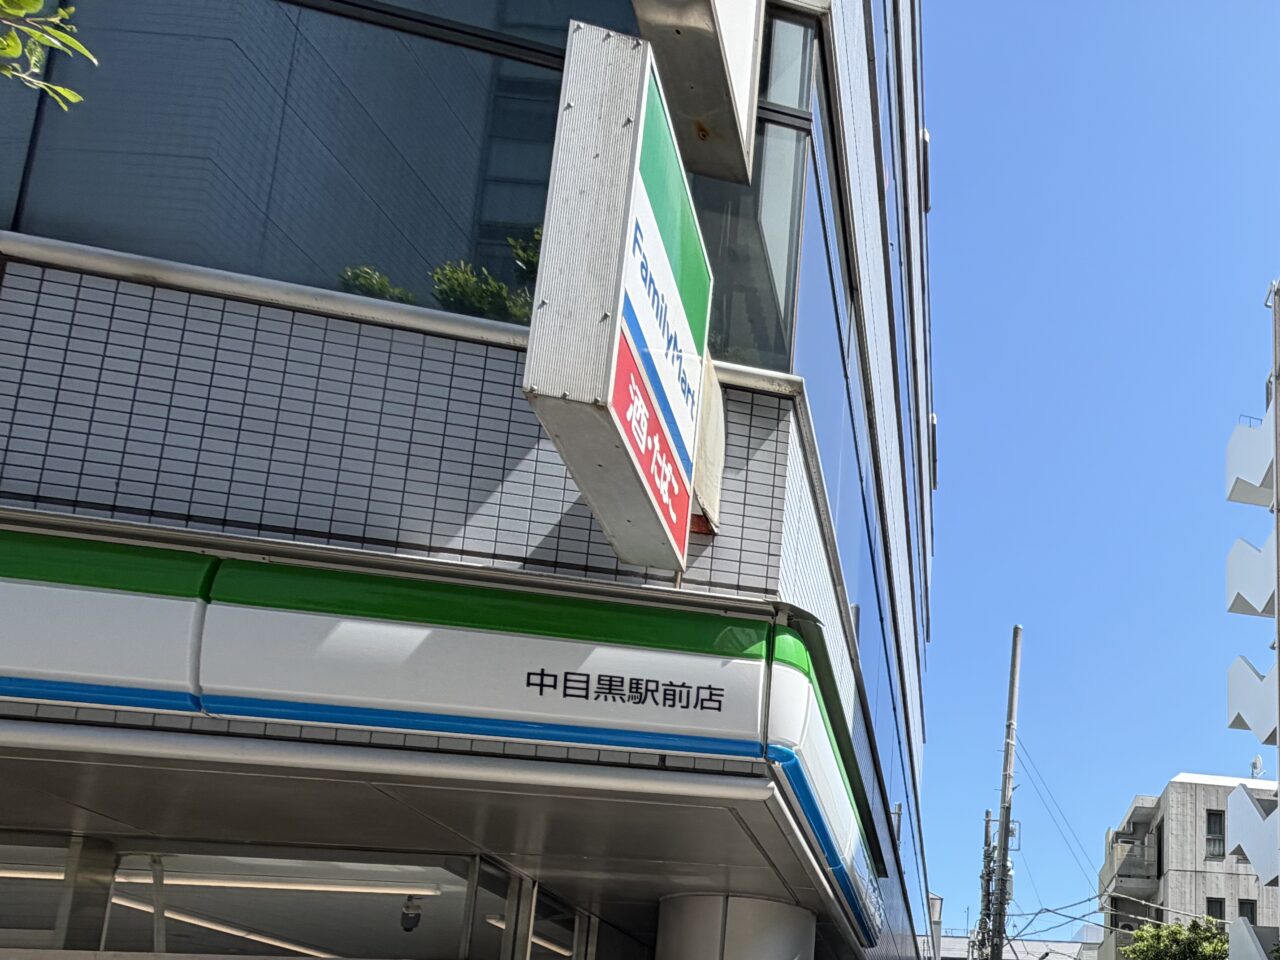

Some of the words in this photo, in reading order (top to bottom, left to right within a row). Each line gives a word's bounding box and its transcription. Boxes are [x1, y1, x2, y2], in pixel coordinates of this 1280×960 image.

[632, 217, 696, 423] FamilyMart
[525, 668, 725, 712] 中目黒駅前店
